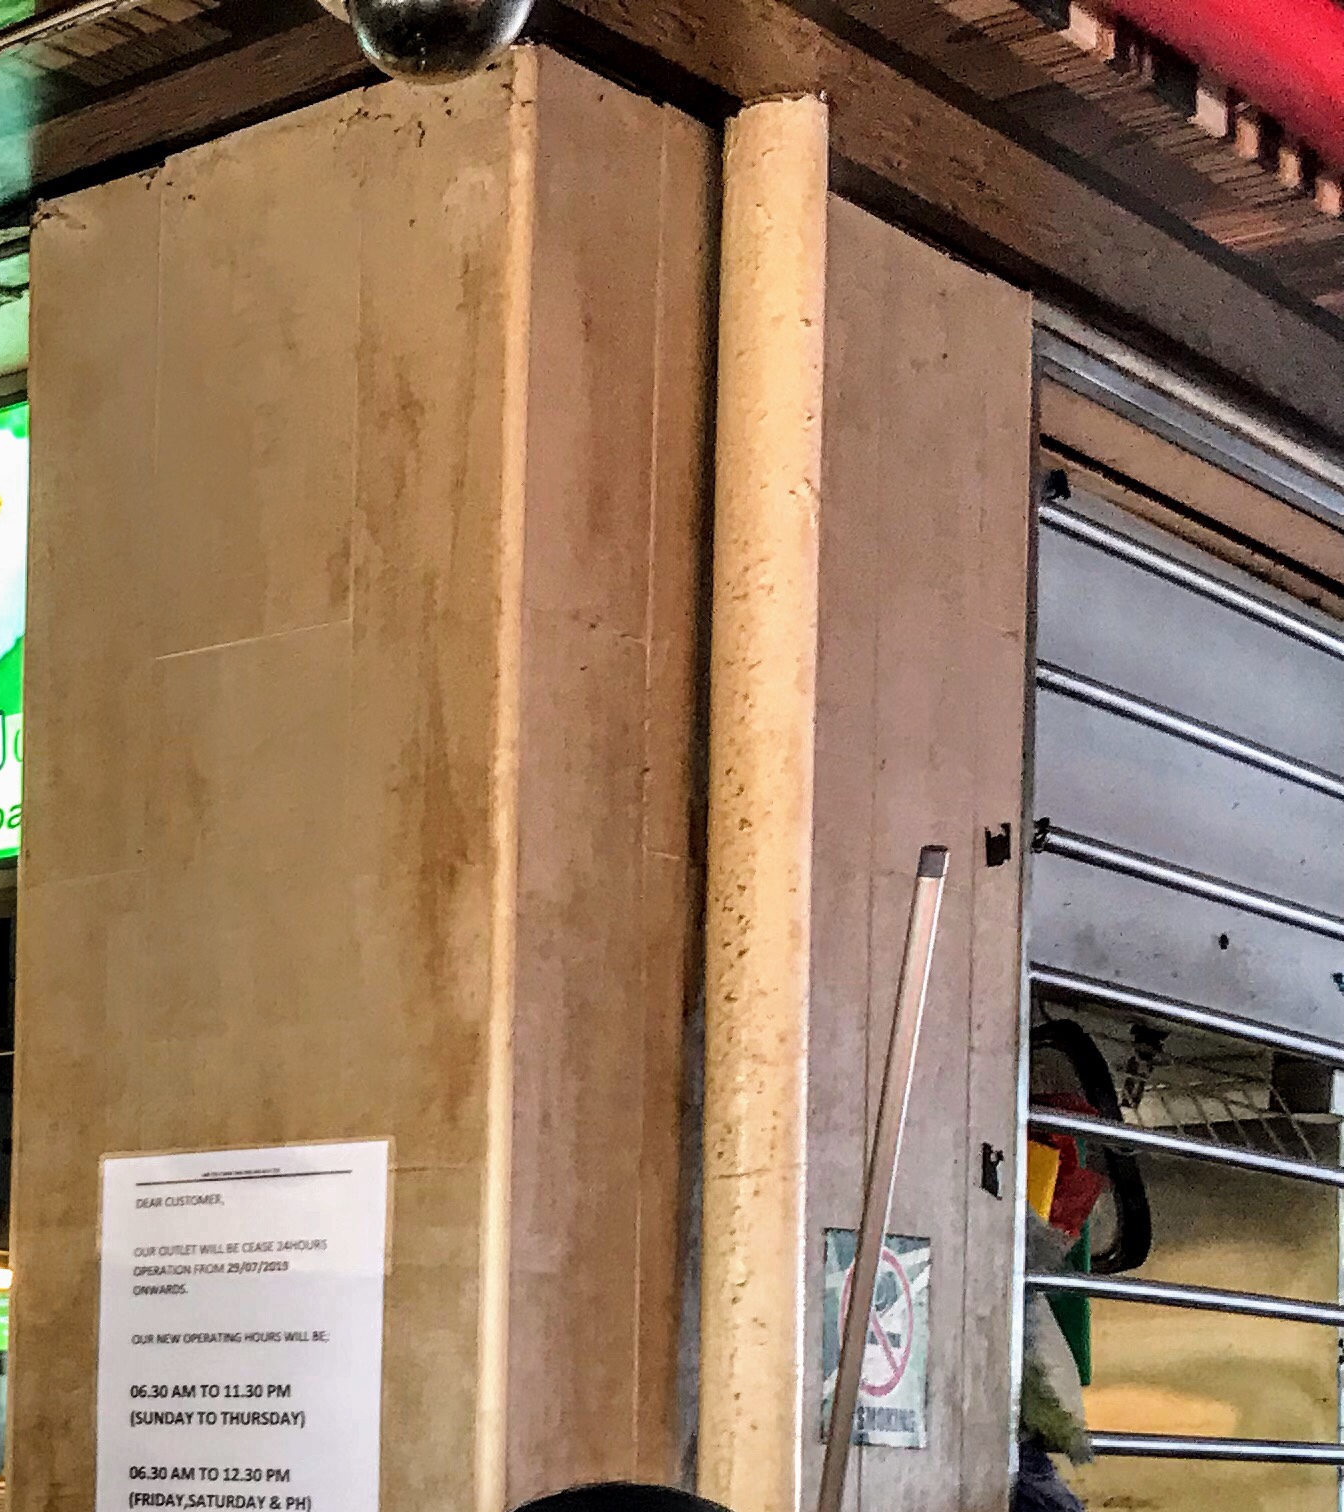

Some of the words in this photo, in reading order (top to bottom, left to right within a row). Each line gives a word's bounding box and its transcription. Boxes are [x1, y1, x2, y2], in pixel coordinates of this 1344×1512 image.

[135, 1197, 162, 1209] DEAR
[134, 1247, 156, 1258] OUR
[158, 1244, 197, 1257] OUTLET
[199, 1243, 224, 1255] WILL
[226, 1243, 240, 1254] BE
[241, 1241, 274, 1253] CEASE
[133, 1264, 192, 1277] OPERATION
[193, 1263, 225, 1275] FROM
[132, 1284, 189, 1296] ONWARDS.
[132, 1334, 155, 1345] OUR
[156, 1334, 180, 1344] NEW
[183, 1332, 242, 1344] OPERATING
[244, 1331, 282, 1343] HOURS
[283, 1331, 310, 1342] WILL
[130, 1384, 168, 1398] 06.30
[171, 1384, 196, 1398] AM
[200, 1384, 220, 1398] TO
[223, 1384, 263, 1398] 11.30
[266, 1384, 292, 1398] PM
[130, 1410, 195, 1427] (SUNDAY
[197, 1411, 217, 1425] TO
[220, 1410, 306, 1428] THURSDAY)
[857, 1406, 915, 1432] SMOKING
[129, 1466, 168, 1480] 06.30
[171, 1466, 195, 1480] AM
[199, 1467, 219, 1481] TO
[223, 1467, 262, 1481] 12.30
[266, 1468, 291, 1482] PM
[129, 1491, 266, 1511] (FRIDAY,SATURDAY
[269, 1496, 282, 1509] &
